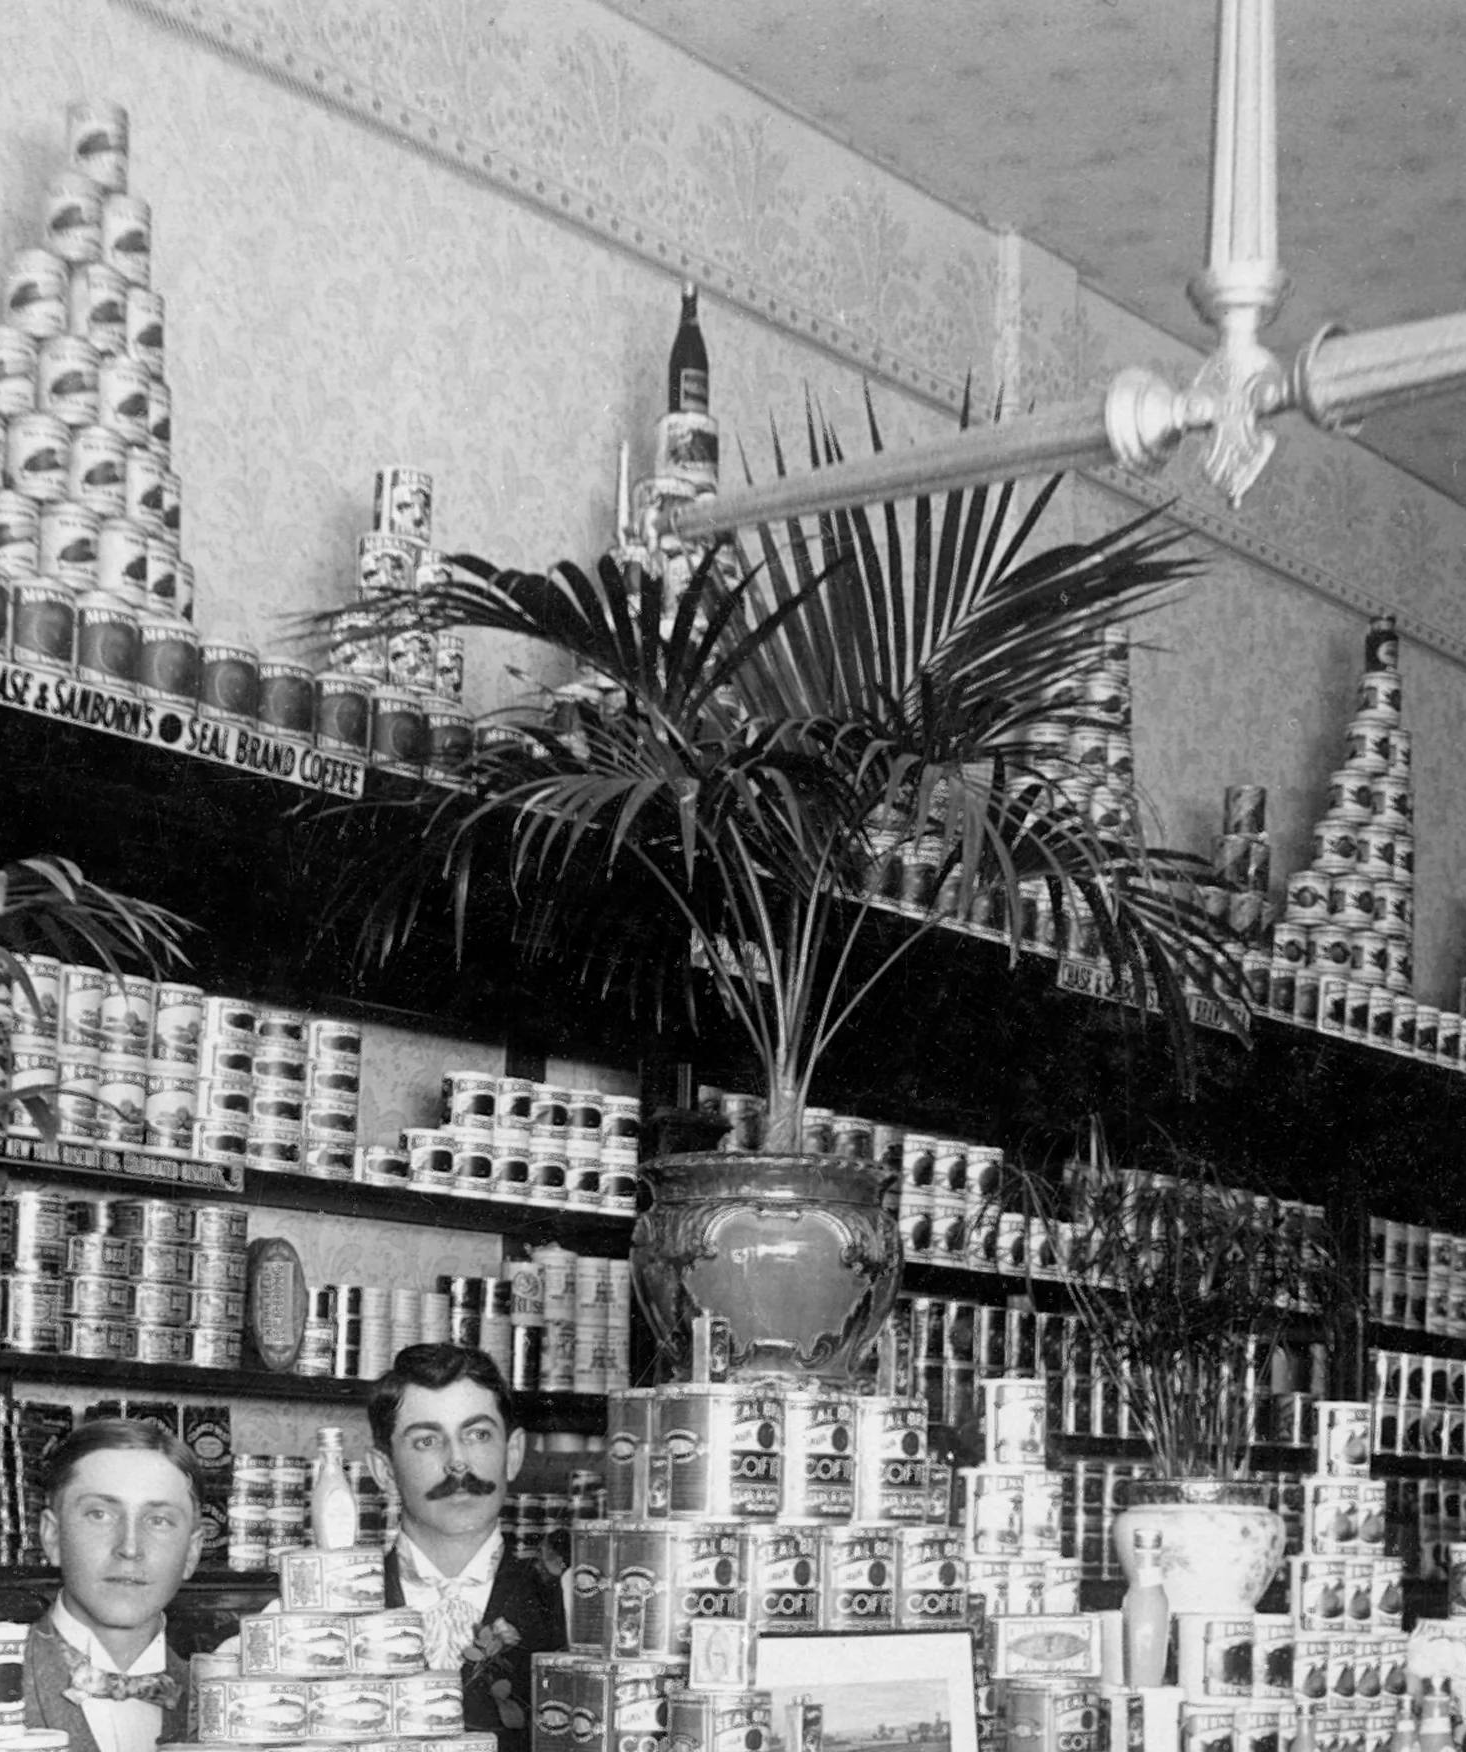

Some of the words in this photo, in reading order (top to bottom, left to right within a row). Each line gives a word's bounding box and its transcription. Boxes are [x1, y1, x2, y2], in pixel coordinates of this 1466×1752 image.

[186, 714, 232, 757] SEAL
[236, 728, 296, 779] BRAND
[299, 746, 362, 797] COFFEE
